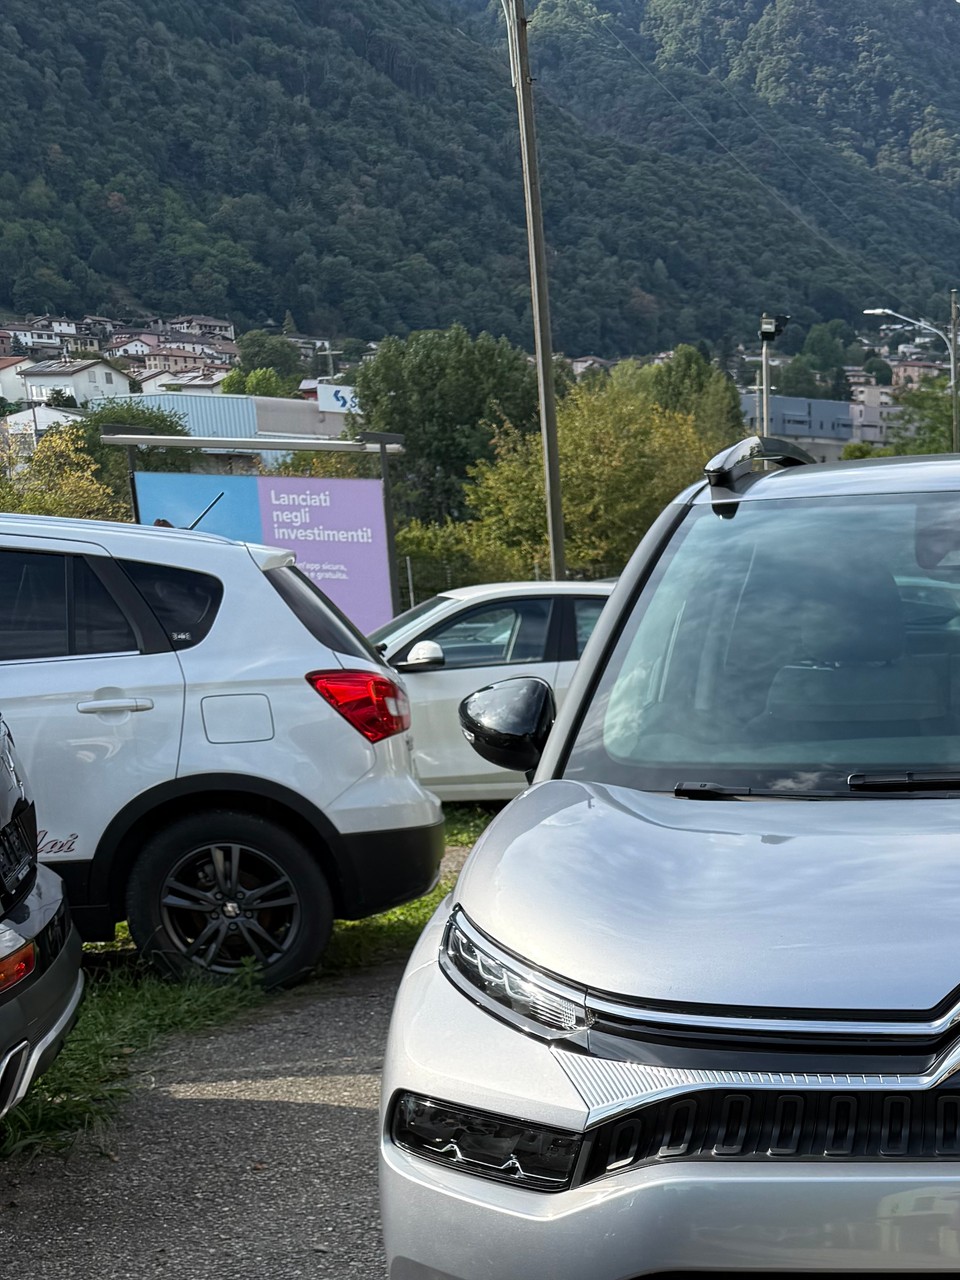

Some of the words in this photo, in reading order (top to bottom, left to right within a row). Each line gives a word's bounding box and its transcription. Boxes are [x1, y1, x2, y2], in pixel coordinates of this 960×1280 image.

[270, 489, 331, 507] Lanciati
[272, 508, 310, 526] negli
[273, 524, 374, 543] investimenti!
